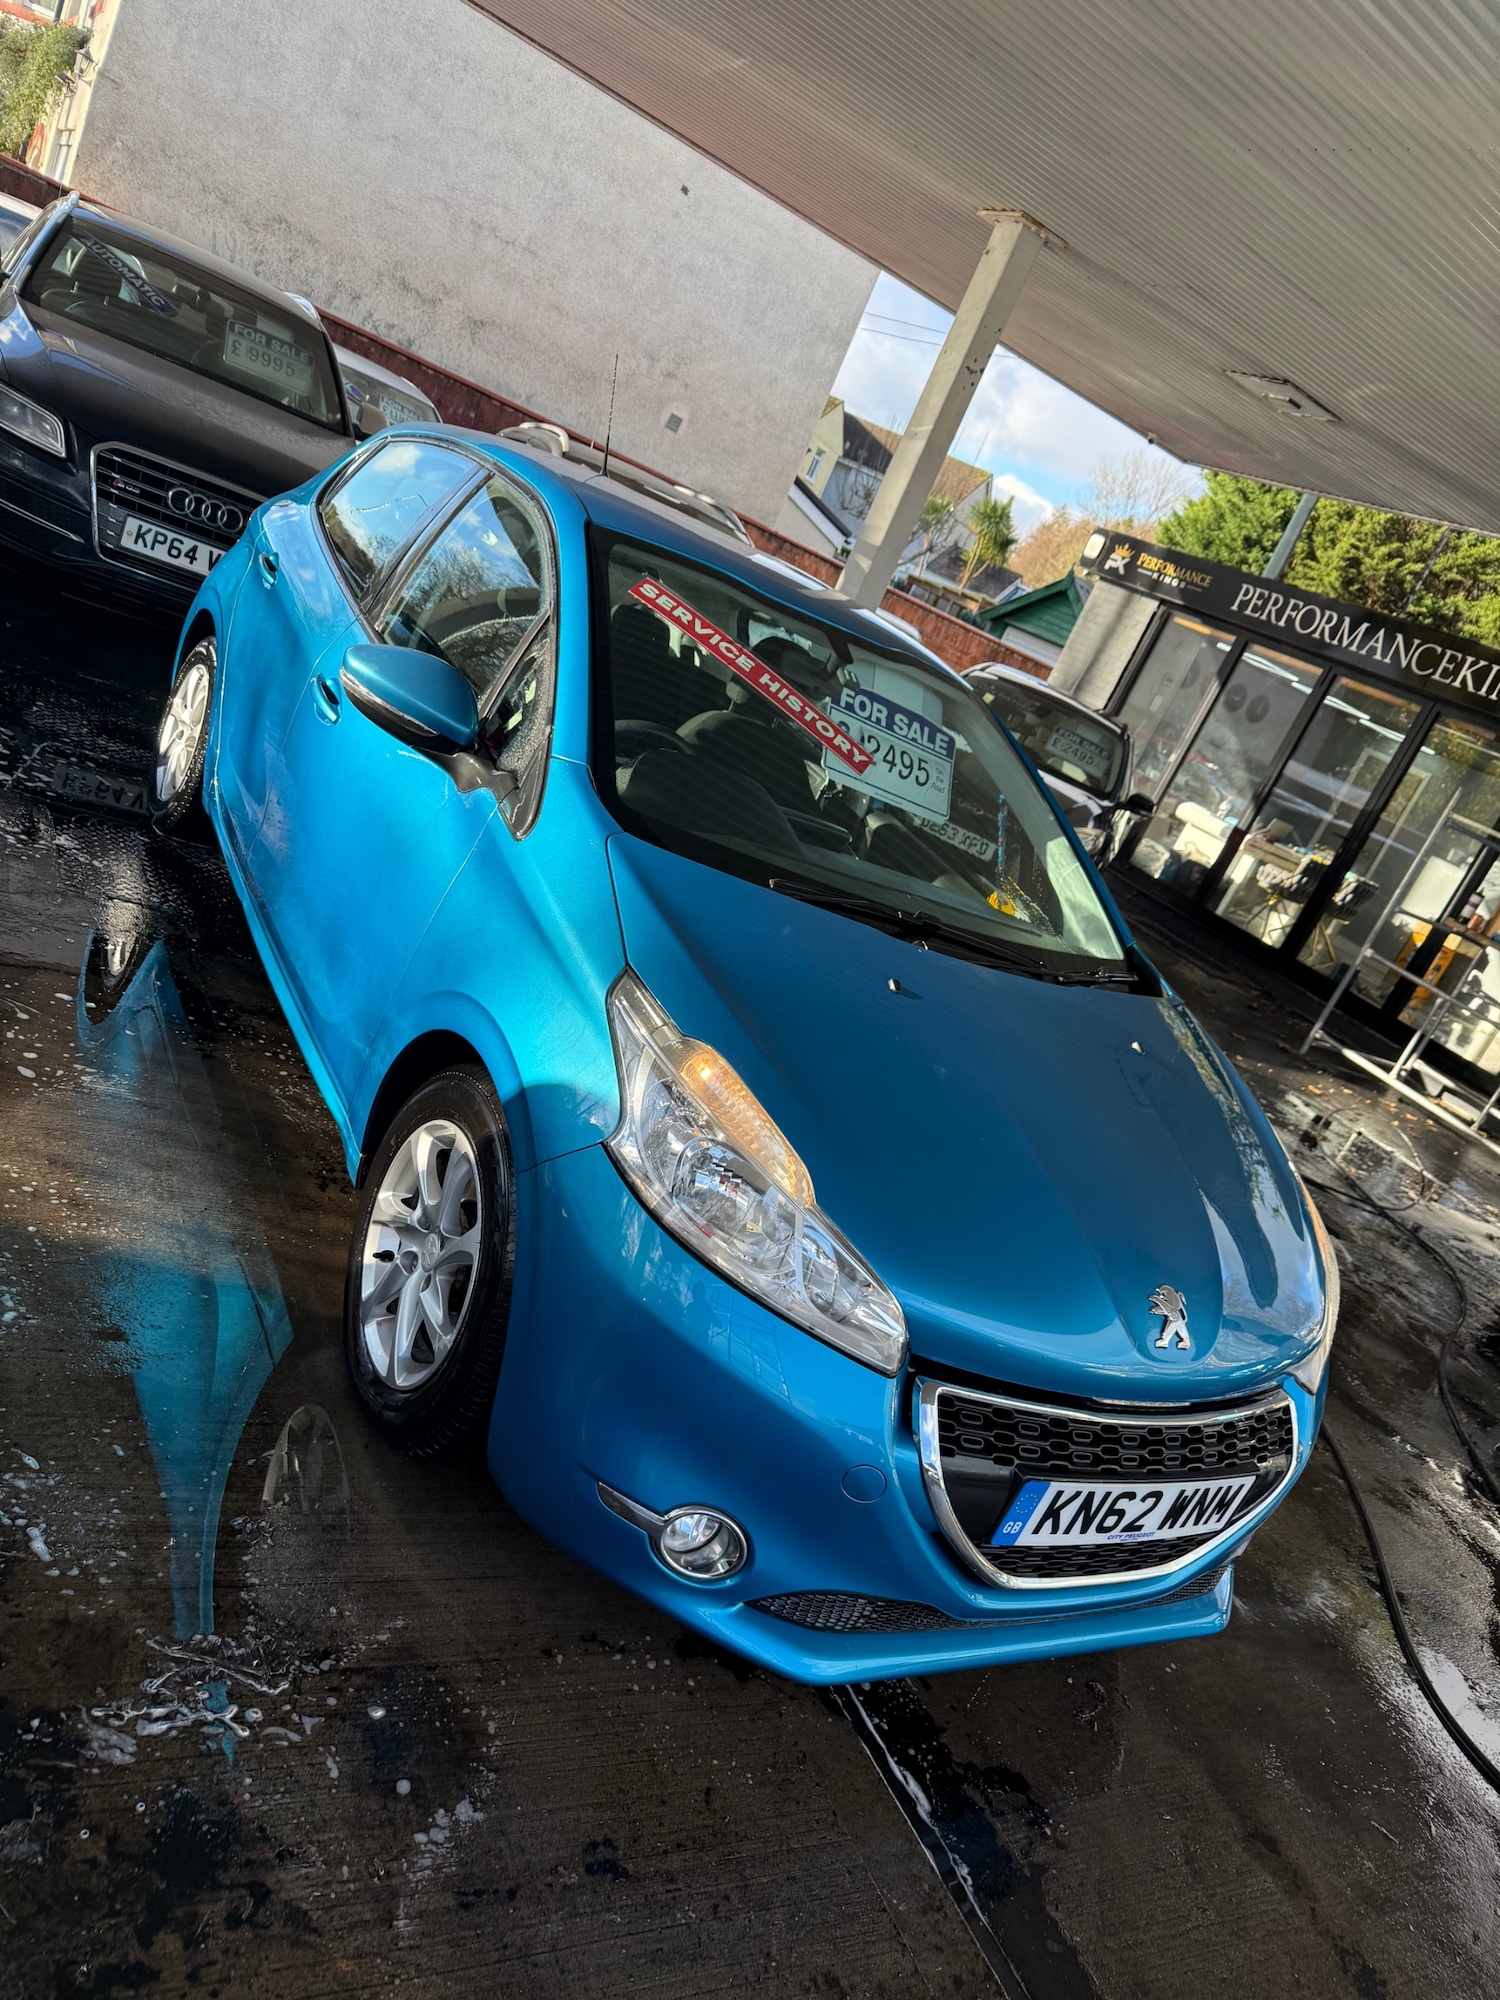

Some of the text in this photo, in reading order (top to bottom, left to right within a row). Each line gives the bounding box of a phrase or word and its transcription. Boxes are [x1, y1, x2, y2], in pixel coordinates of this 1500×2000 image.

[81, 238, 165, 306] AUTOMATIC
[235, 324, 309, 362] FOR SALE
[134, 525, 199, 565] KP64
[1136, 553, 1213, 588] PERFORMANCE
[1151, 572, 1186, 588] KINGS
[639, 583, 869, 763] SERVICE HISTORY
[840, 688, 949, 755] FOR SALE
[1002, 1521, 1022, 1534] GB
[1031, 1484, 1245, 1534] KN62 WNM
[1124, 1531, 1156, 1539] PEUGEOT
